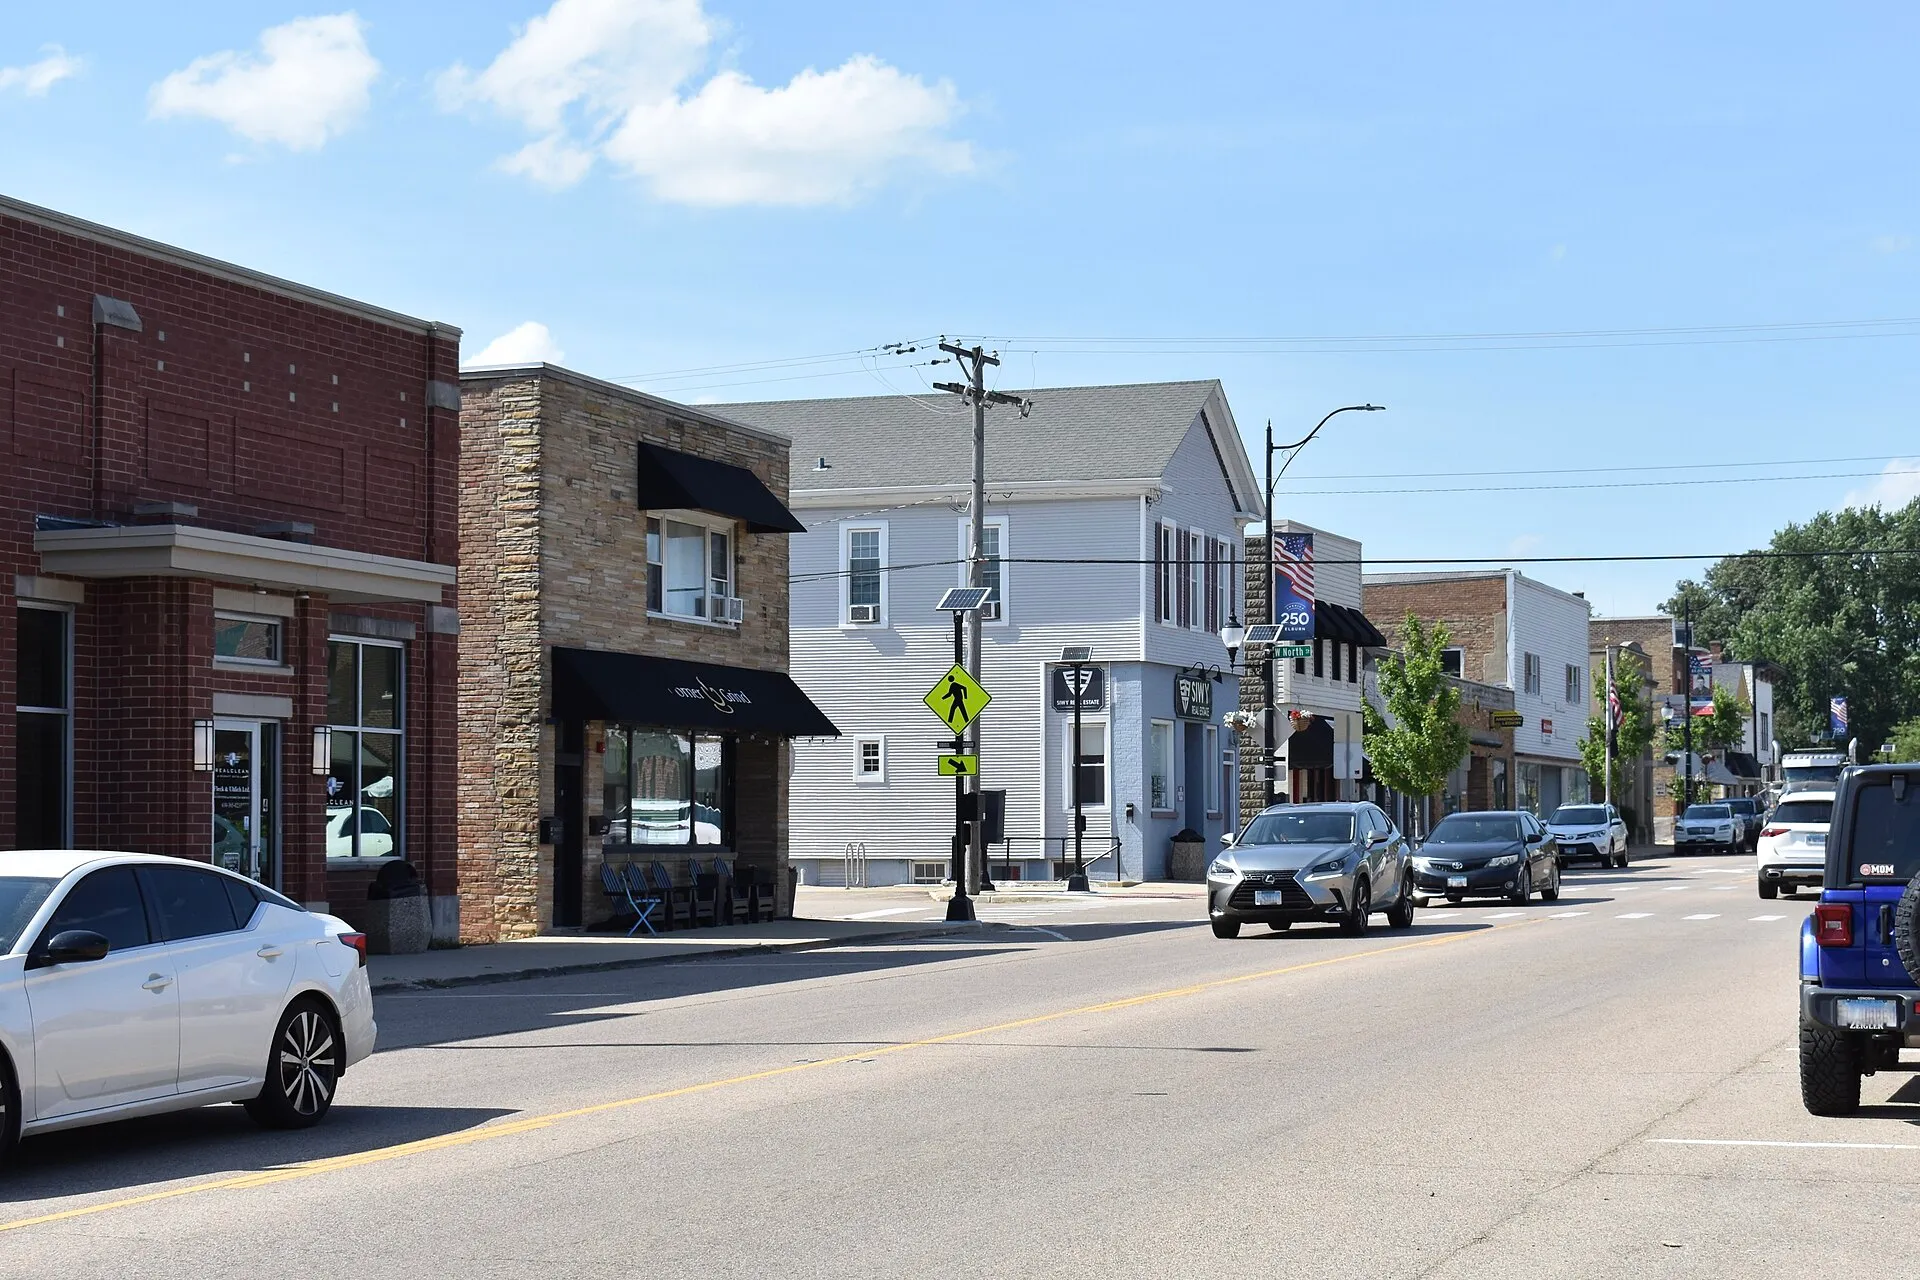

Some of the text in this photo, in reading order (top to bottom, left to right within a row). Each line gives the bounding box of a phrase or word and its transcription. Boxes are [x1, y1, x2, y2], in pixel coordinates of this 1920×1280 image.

[1280, 612, 1309, 625] 250
[1274, 647, 1281, 657] W
[1282, 647, 1304, 657] North
[1191, 680, 1210, 704] SIWY
[1870, 864, 1895, 874] MOM
[1849, 1022, 1884, 1030] ZEIGLER
